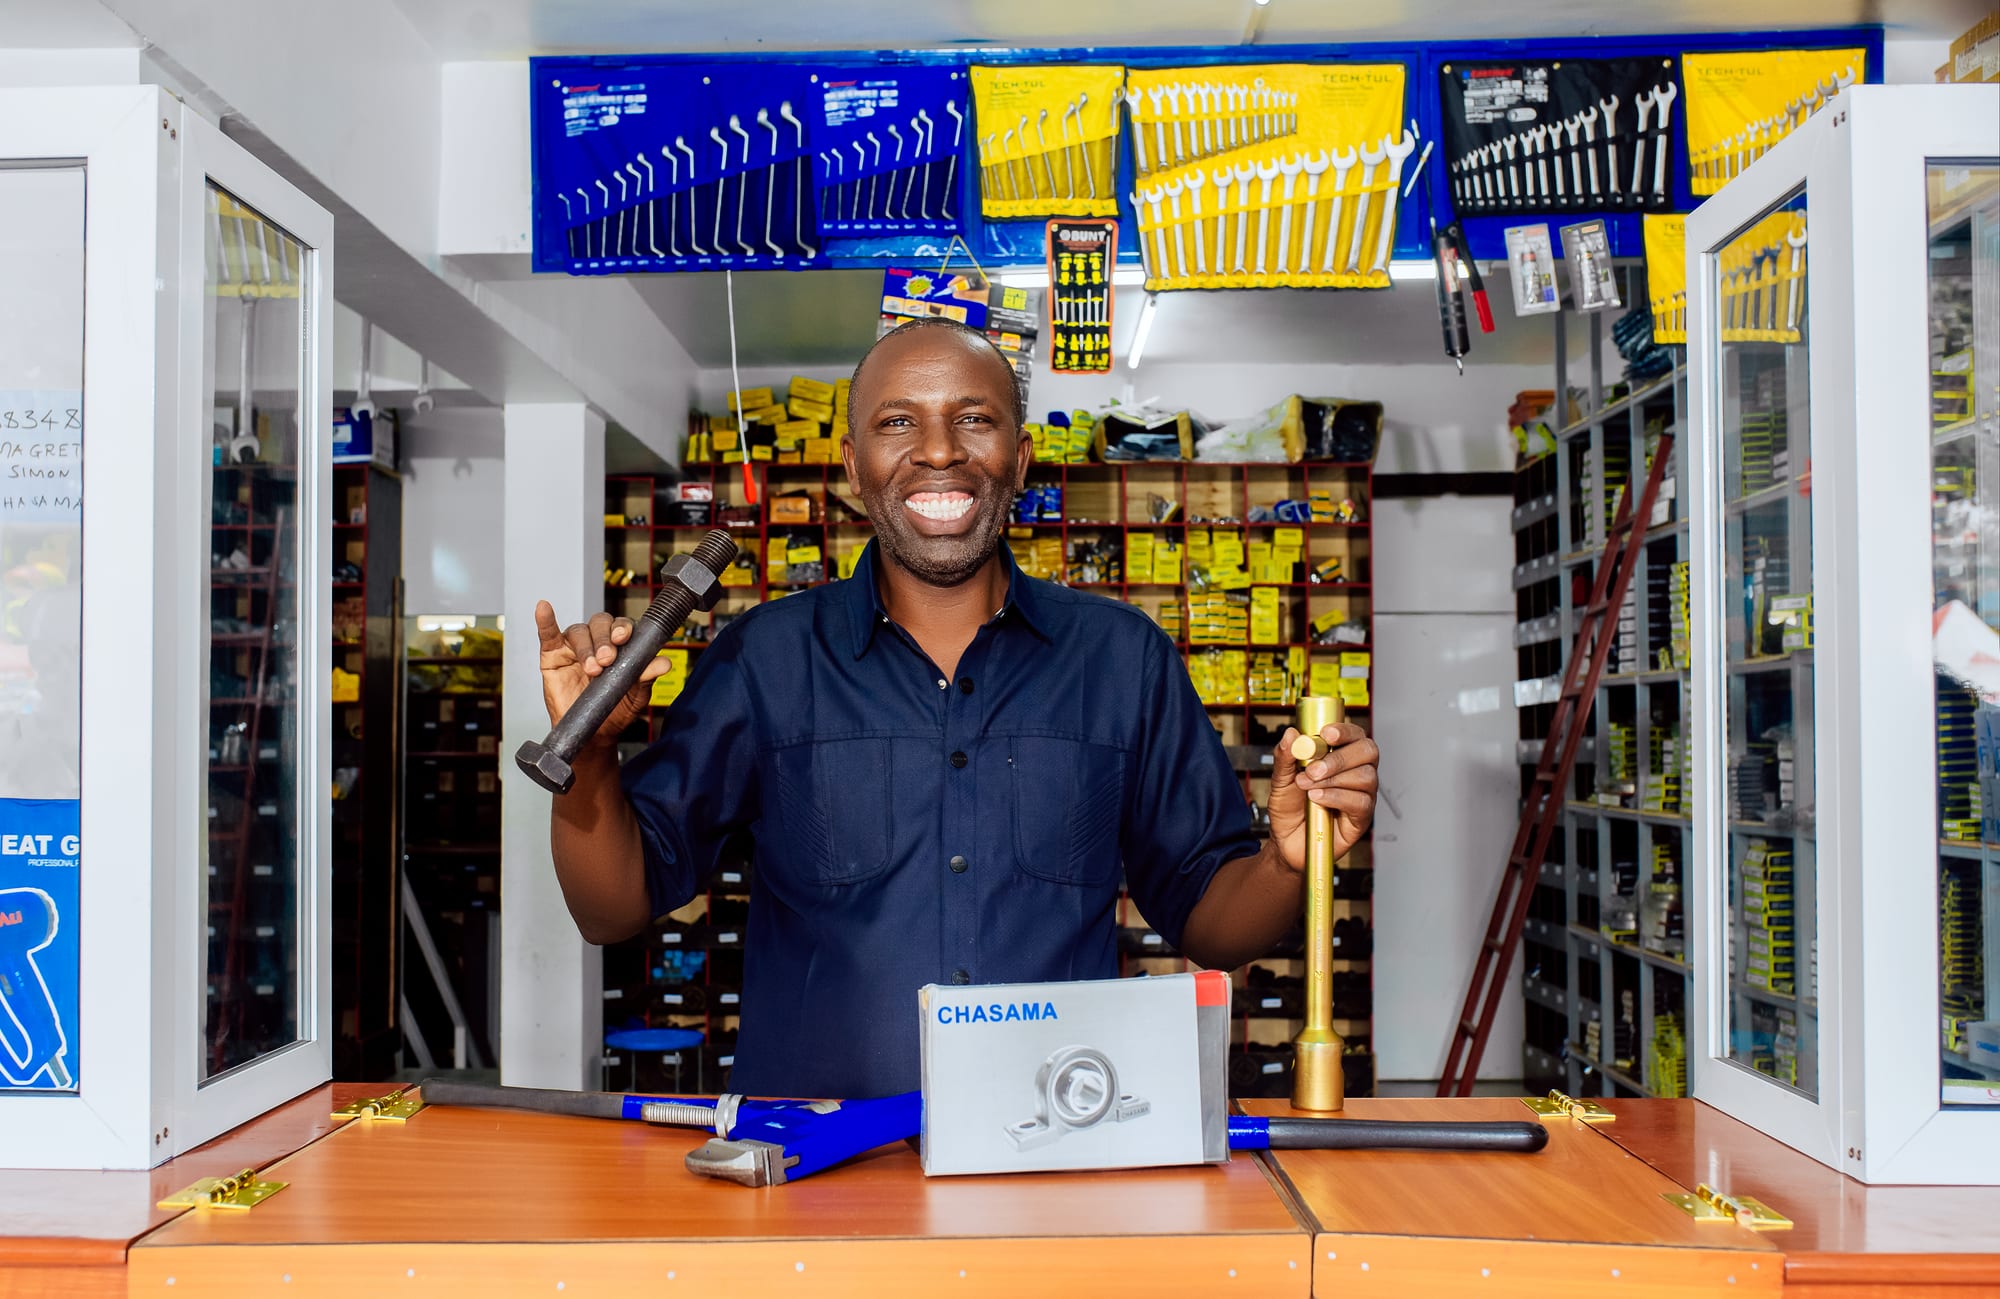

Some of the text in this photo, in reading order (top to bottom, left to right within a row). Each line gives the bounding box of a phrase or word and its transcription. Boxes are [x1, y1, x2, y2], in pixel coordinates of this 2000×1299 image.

[1071, 230, 1106, 242] BUNT
[0, 408, 82, 431] 8348
[8, 465, 70, 479] SIMON
[0, 834, 80, 856] EAT G
[937, 1001, 1058, 1025] CHASAMA
